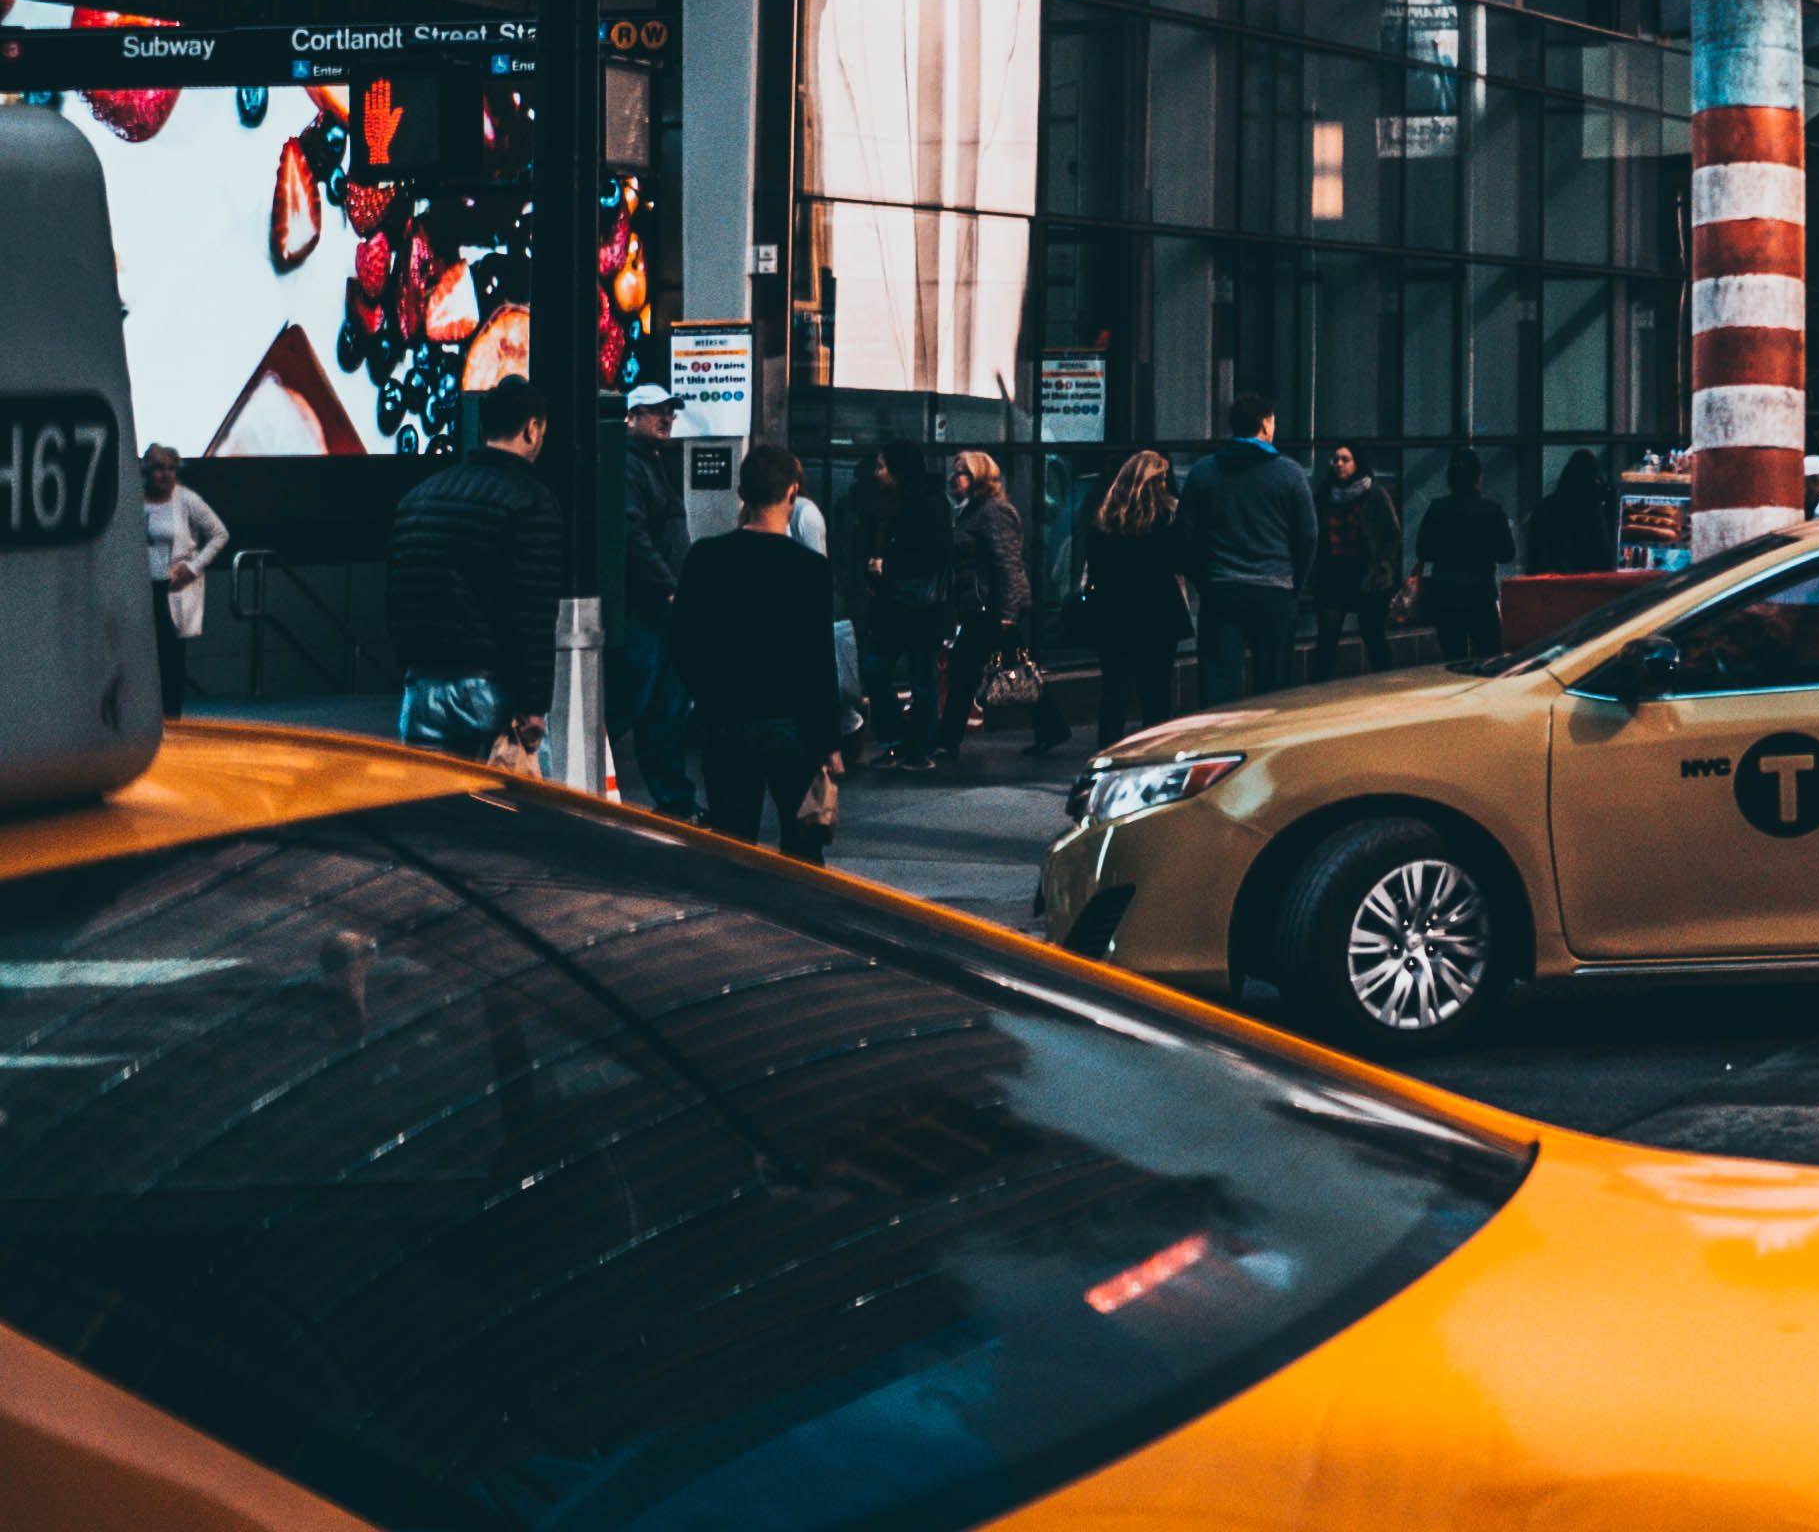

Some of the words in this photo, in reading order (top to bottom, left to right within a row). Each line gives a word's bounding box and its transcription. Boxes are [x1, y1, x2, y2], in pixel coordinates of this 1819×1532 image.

[123, 35, 216, 61] Subway
[291, 27, 405, 51] Cortlandt
[313, 65, 343, 78] Enter
[1680, 757, 1731, 778] NYC
[1758, 754, 1815, 824] T
